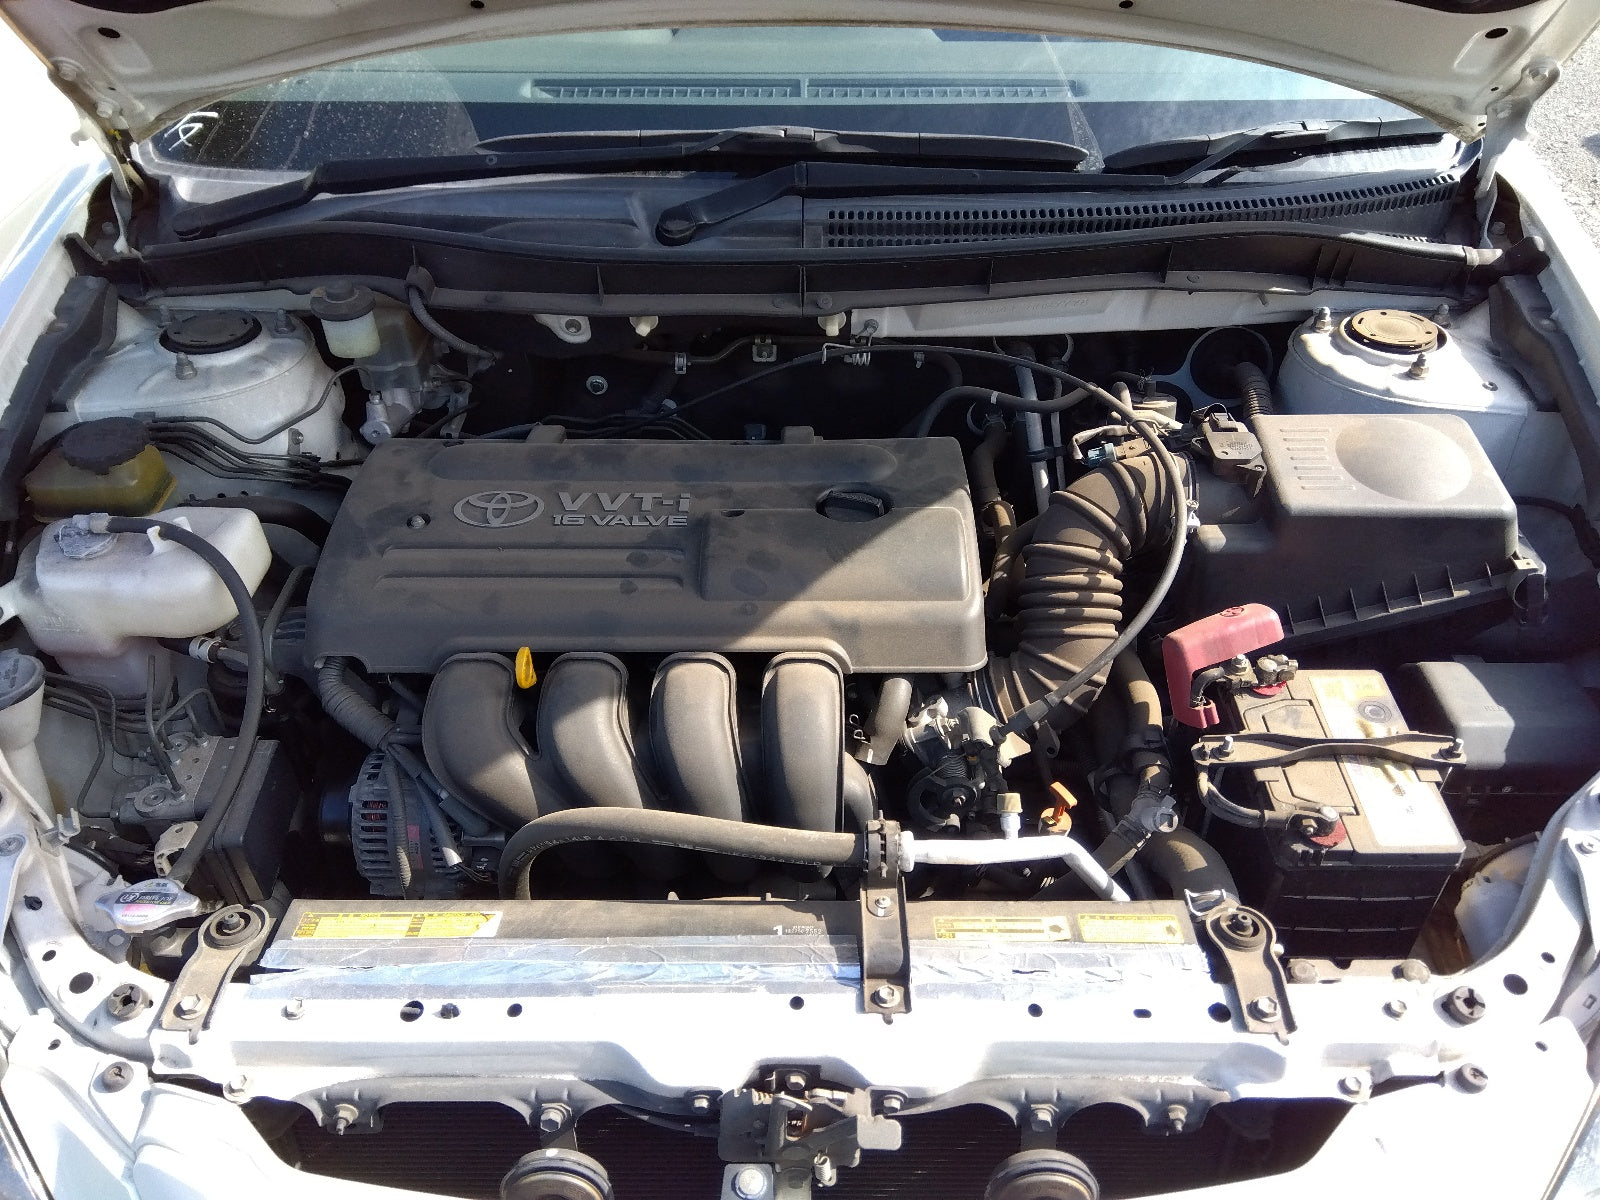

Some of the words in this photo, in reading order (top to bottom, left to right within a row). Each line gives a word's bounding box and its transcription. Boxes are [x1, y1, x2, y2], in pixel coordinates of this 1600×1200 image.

[558, 492, 691, 512] VVT-i
[553, 514, 586, 526] 16
[590, 514, 688, 526] VALVE
